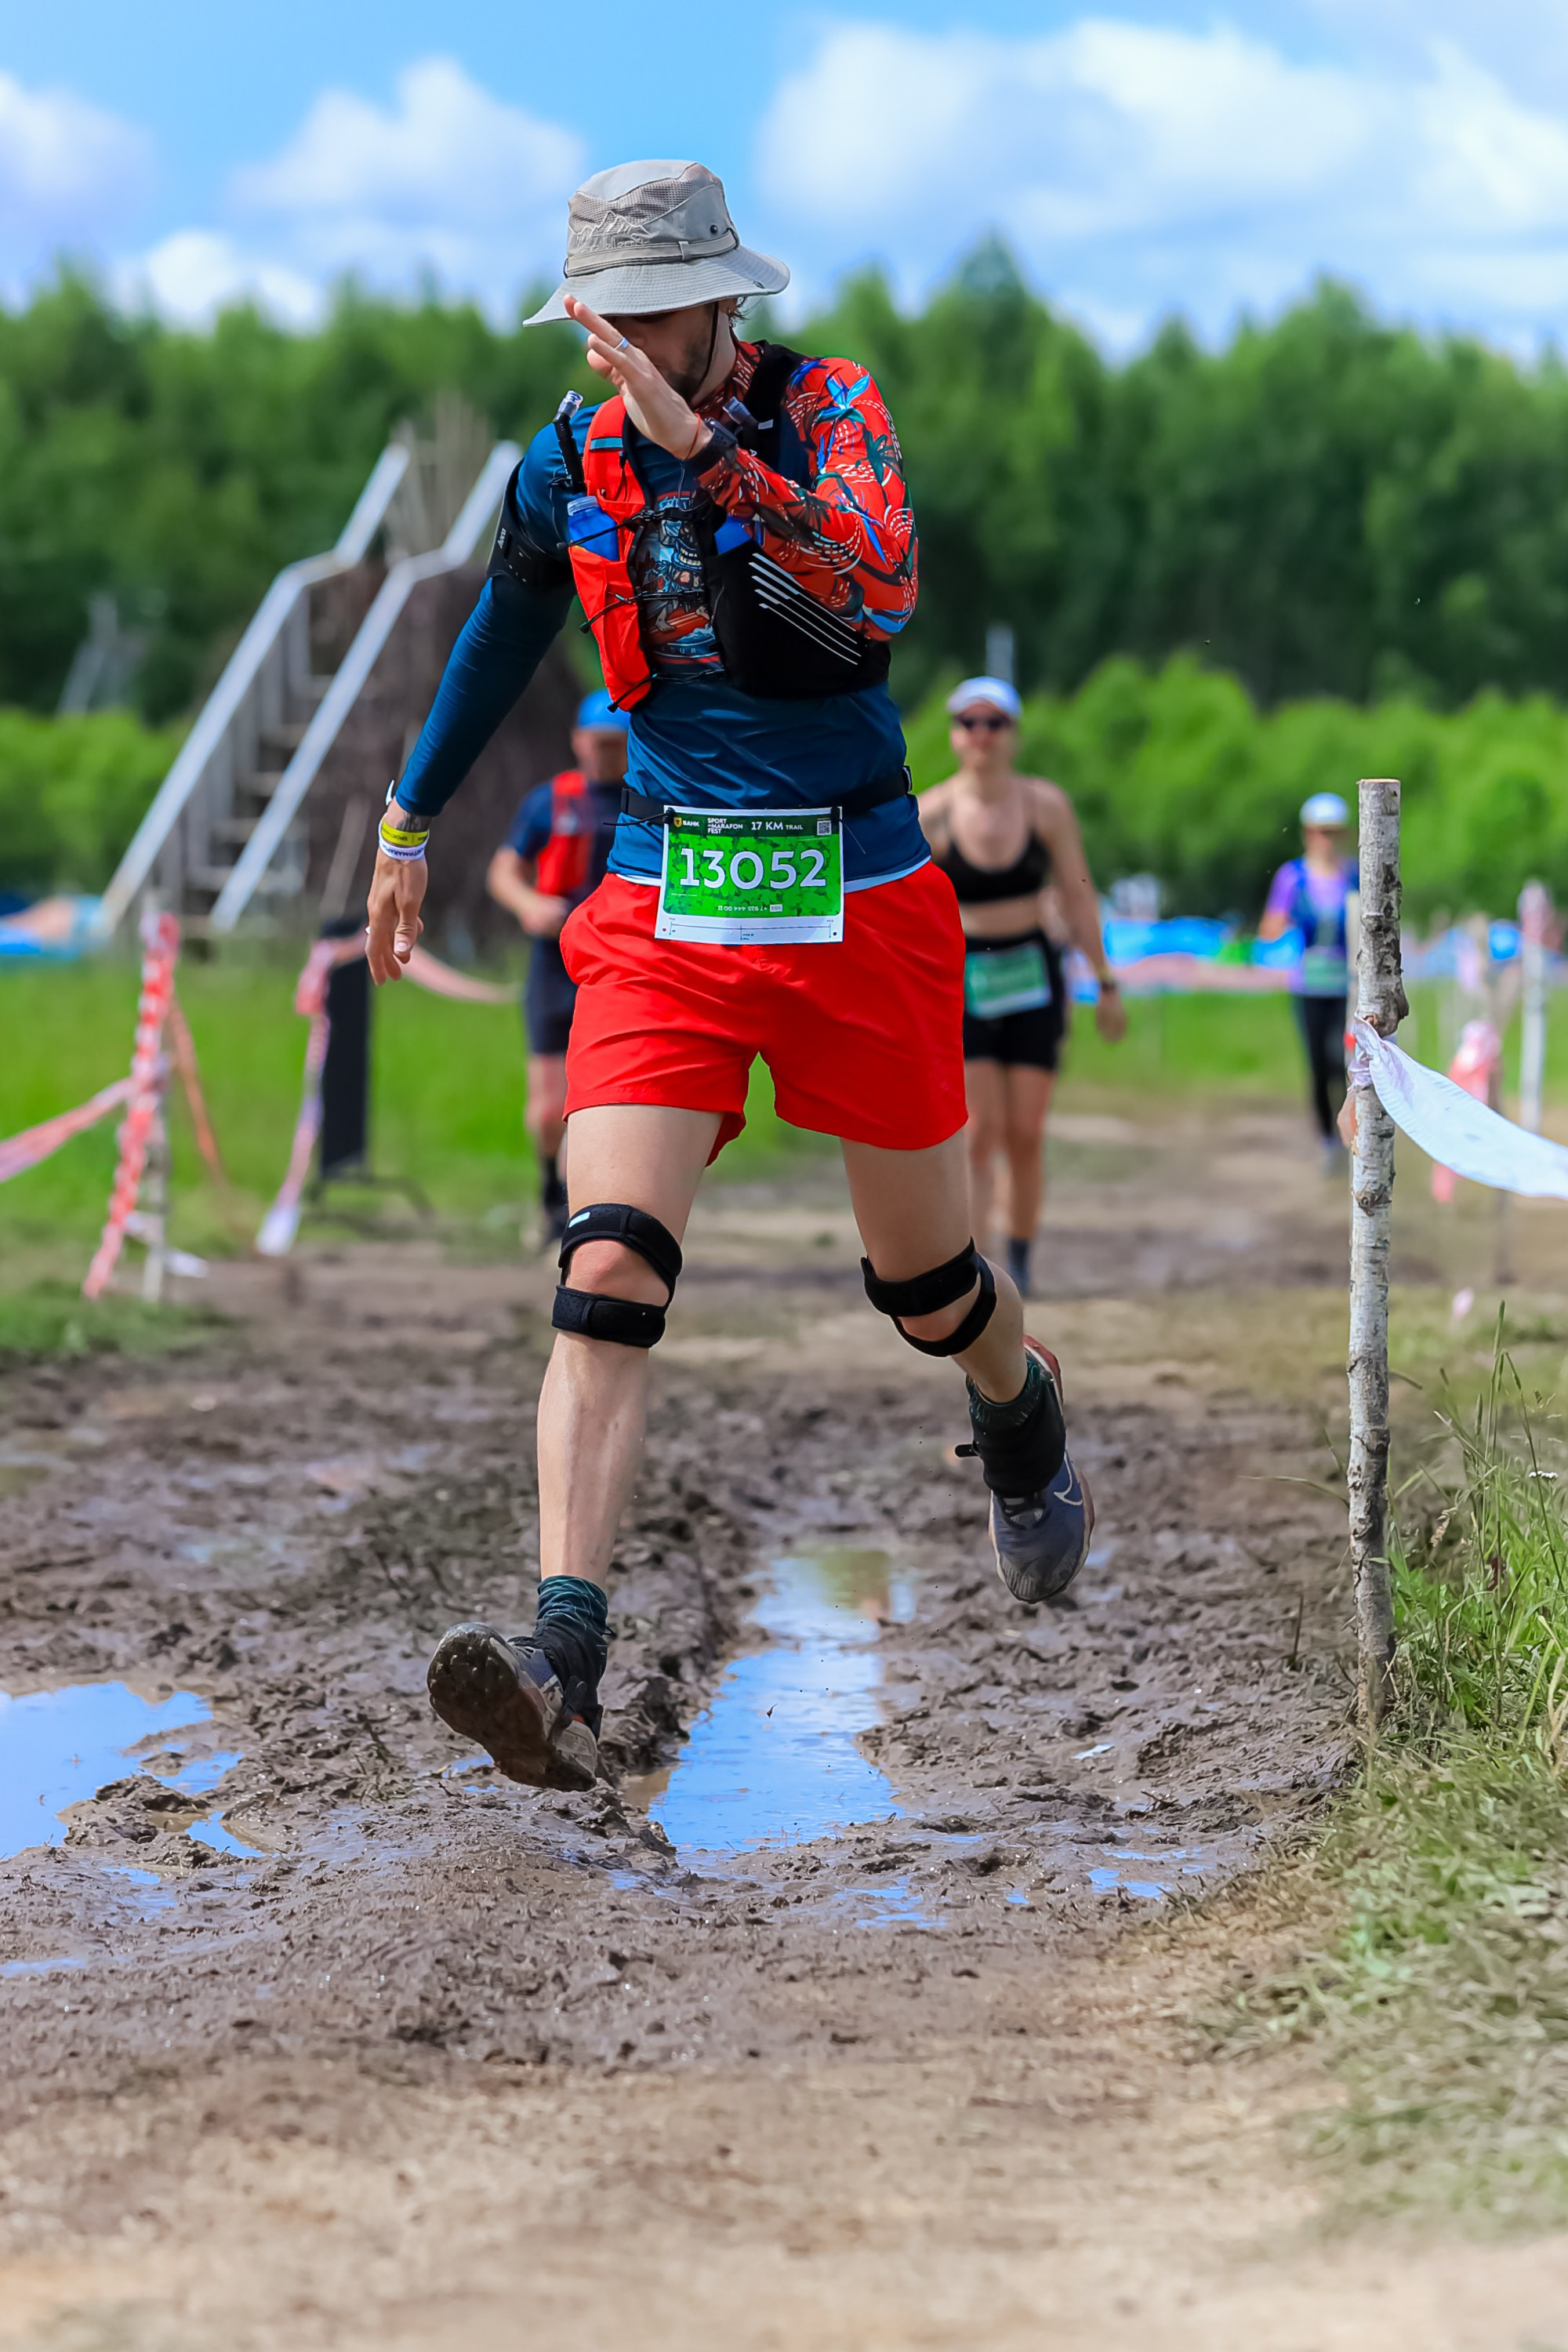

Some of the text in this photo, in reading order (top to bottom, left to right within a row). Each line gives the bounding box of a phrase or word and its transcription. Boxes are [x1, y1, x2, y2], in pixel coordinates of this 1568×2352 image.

[751, 821, 762, 830] 17
[765, 821, 784, 830] KM
[680, 848, 826, 889] 13052
